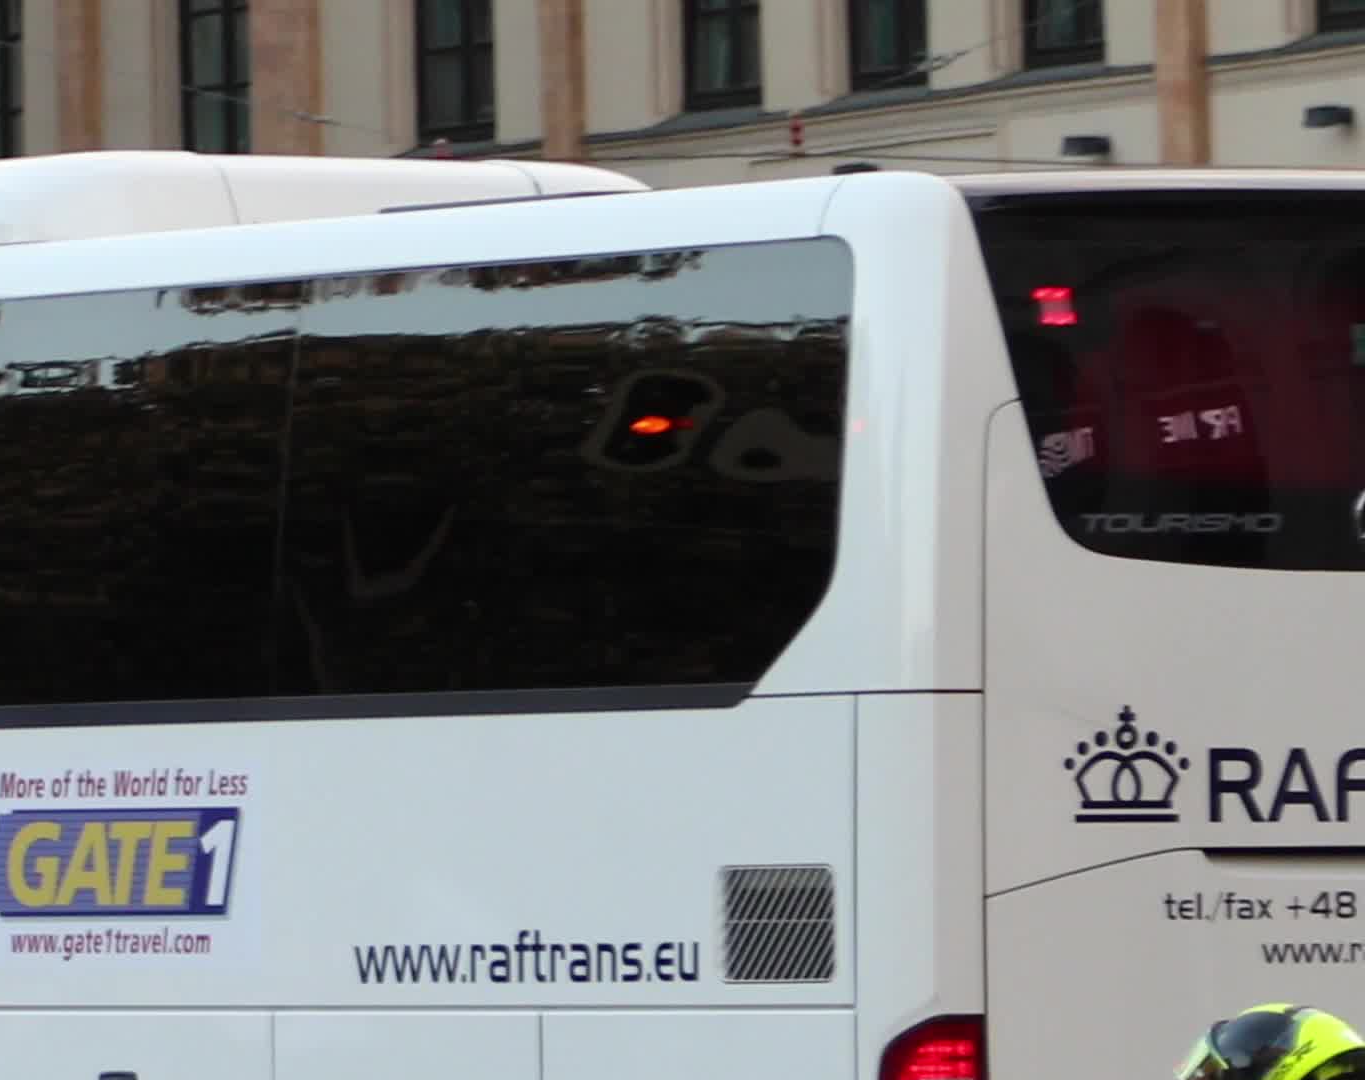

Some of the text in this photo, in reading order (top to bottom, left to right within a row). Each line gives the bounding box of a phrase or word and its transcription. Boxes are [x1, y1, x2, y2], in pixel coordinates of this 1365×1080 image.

[1080, 513, 1283, 533] TOURISMO
[51, 770, 73, 797] of
[77, 769, 106, 798] the
[113, 768, 170, 798] World
[175, 768, 203, 797] for
[208, 769, 248, 797] Less
[1285, 890, 1358, 919] +48
[10, 928, 211, 961] www.gate1travel.com
[354, 929, 701, 984] www.raftrans.eu
[1262, 942, 1365, 964] www.r
